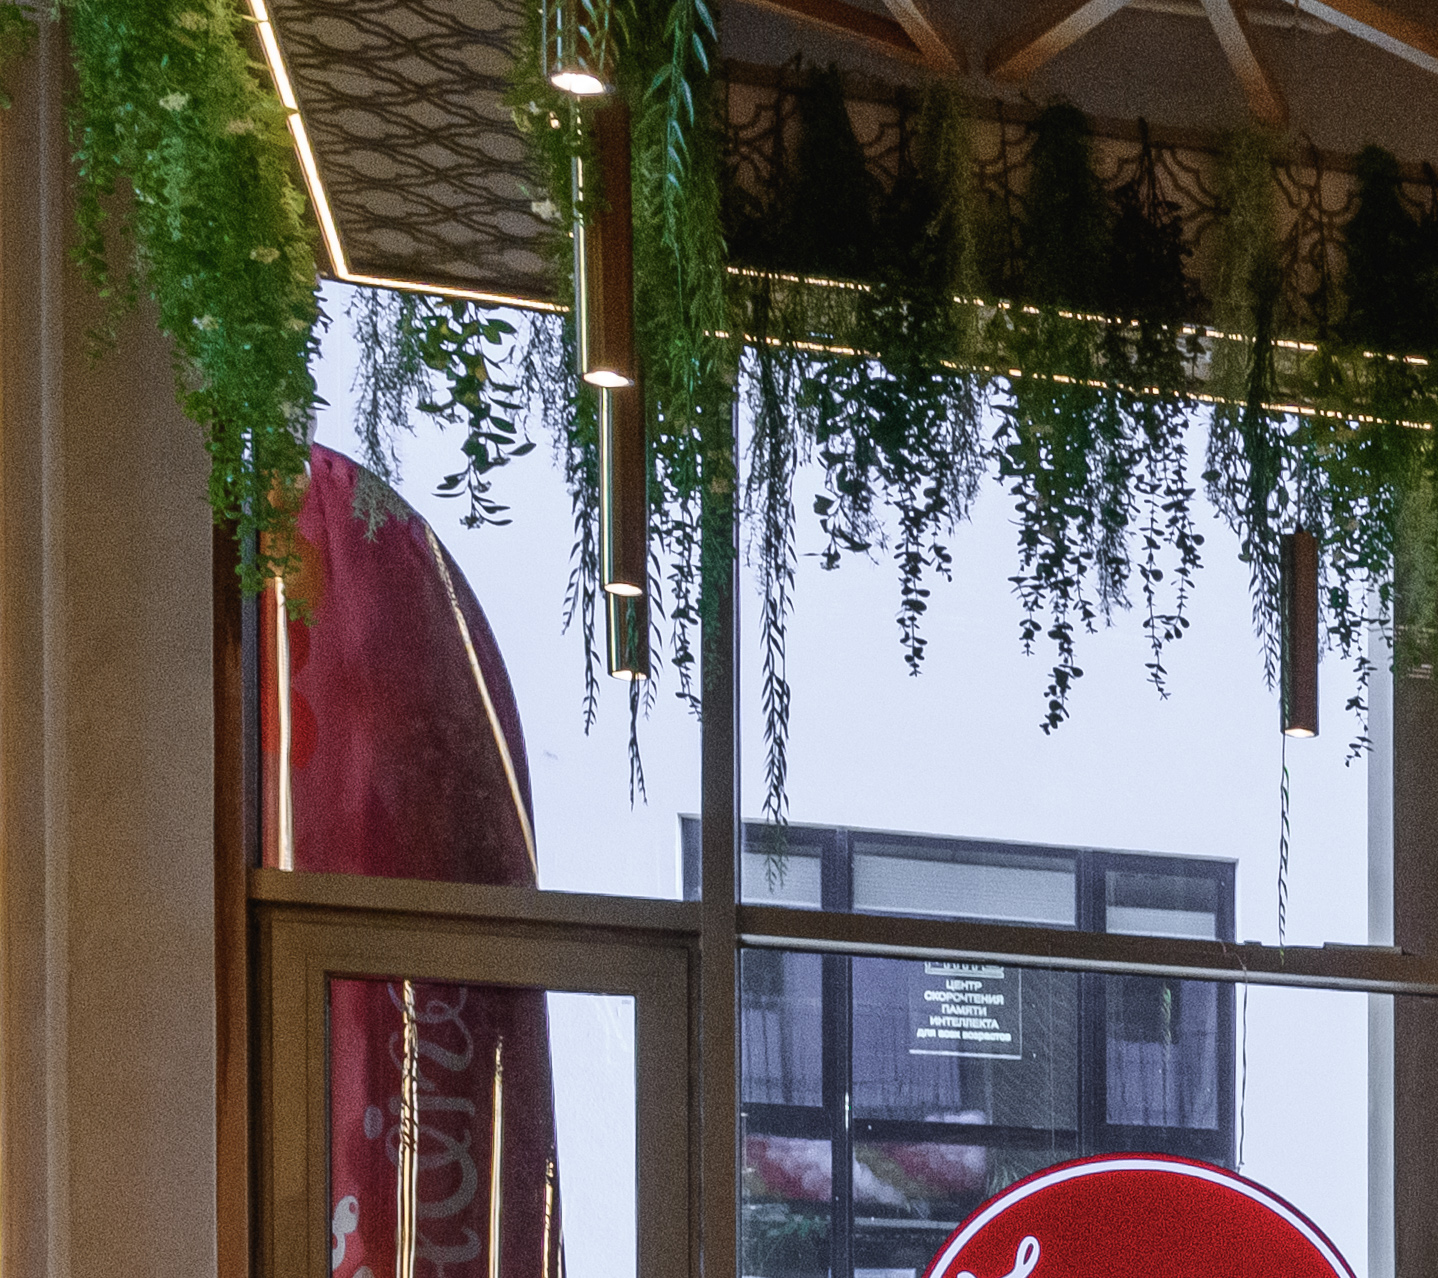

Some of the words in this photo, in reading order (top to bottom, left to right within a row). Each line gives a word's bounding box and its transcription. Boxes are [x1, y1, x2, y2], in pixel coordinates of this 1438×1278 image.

[946, 979, 982, 991] ЦЕНТР
[924, 990, 1004, 1005] СКОРОЧТЕНИЯ
[942, 1004, 987, 1016] ПАМЯТИ
[930, 1016, 999, 1029] ИНТЕЛЛЕКТА
